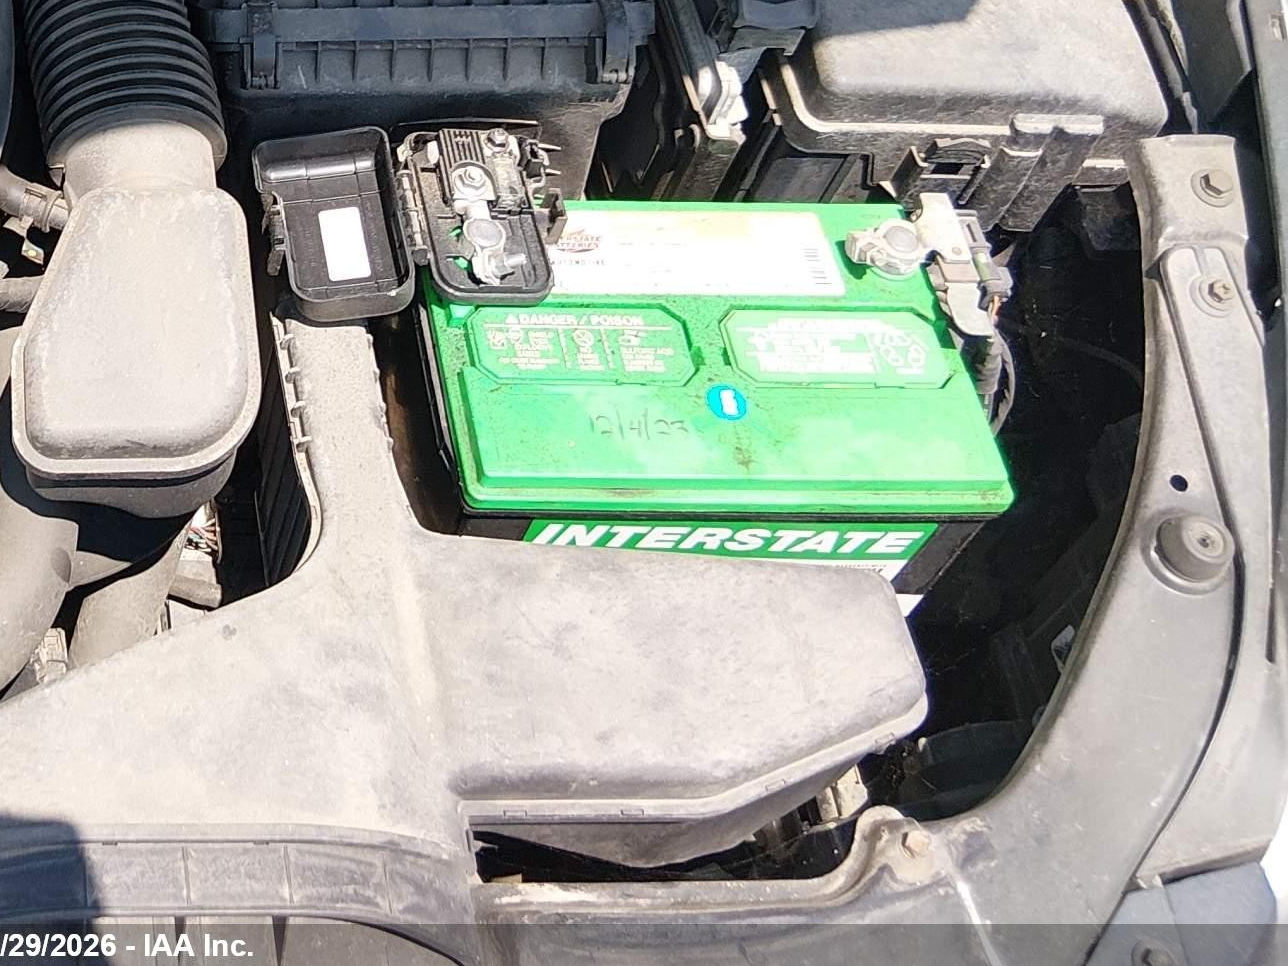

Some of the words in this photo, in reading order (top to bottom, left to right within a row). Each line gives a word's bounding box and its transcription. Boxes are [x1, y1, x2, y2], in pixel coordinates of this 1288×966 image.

[519, 314, 577, 326] DANGER
[591, 315, 644, 326] POISON
[532, 523, 925, 555] INTERSTATE
